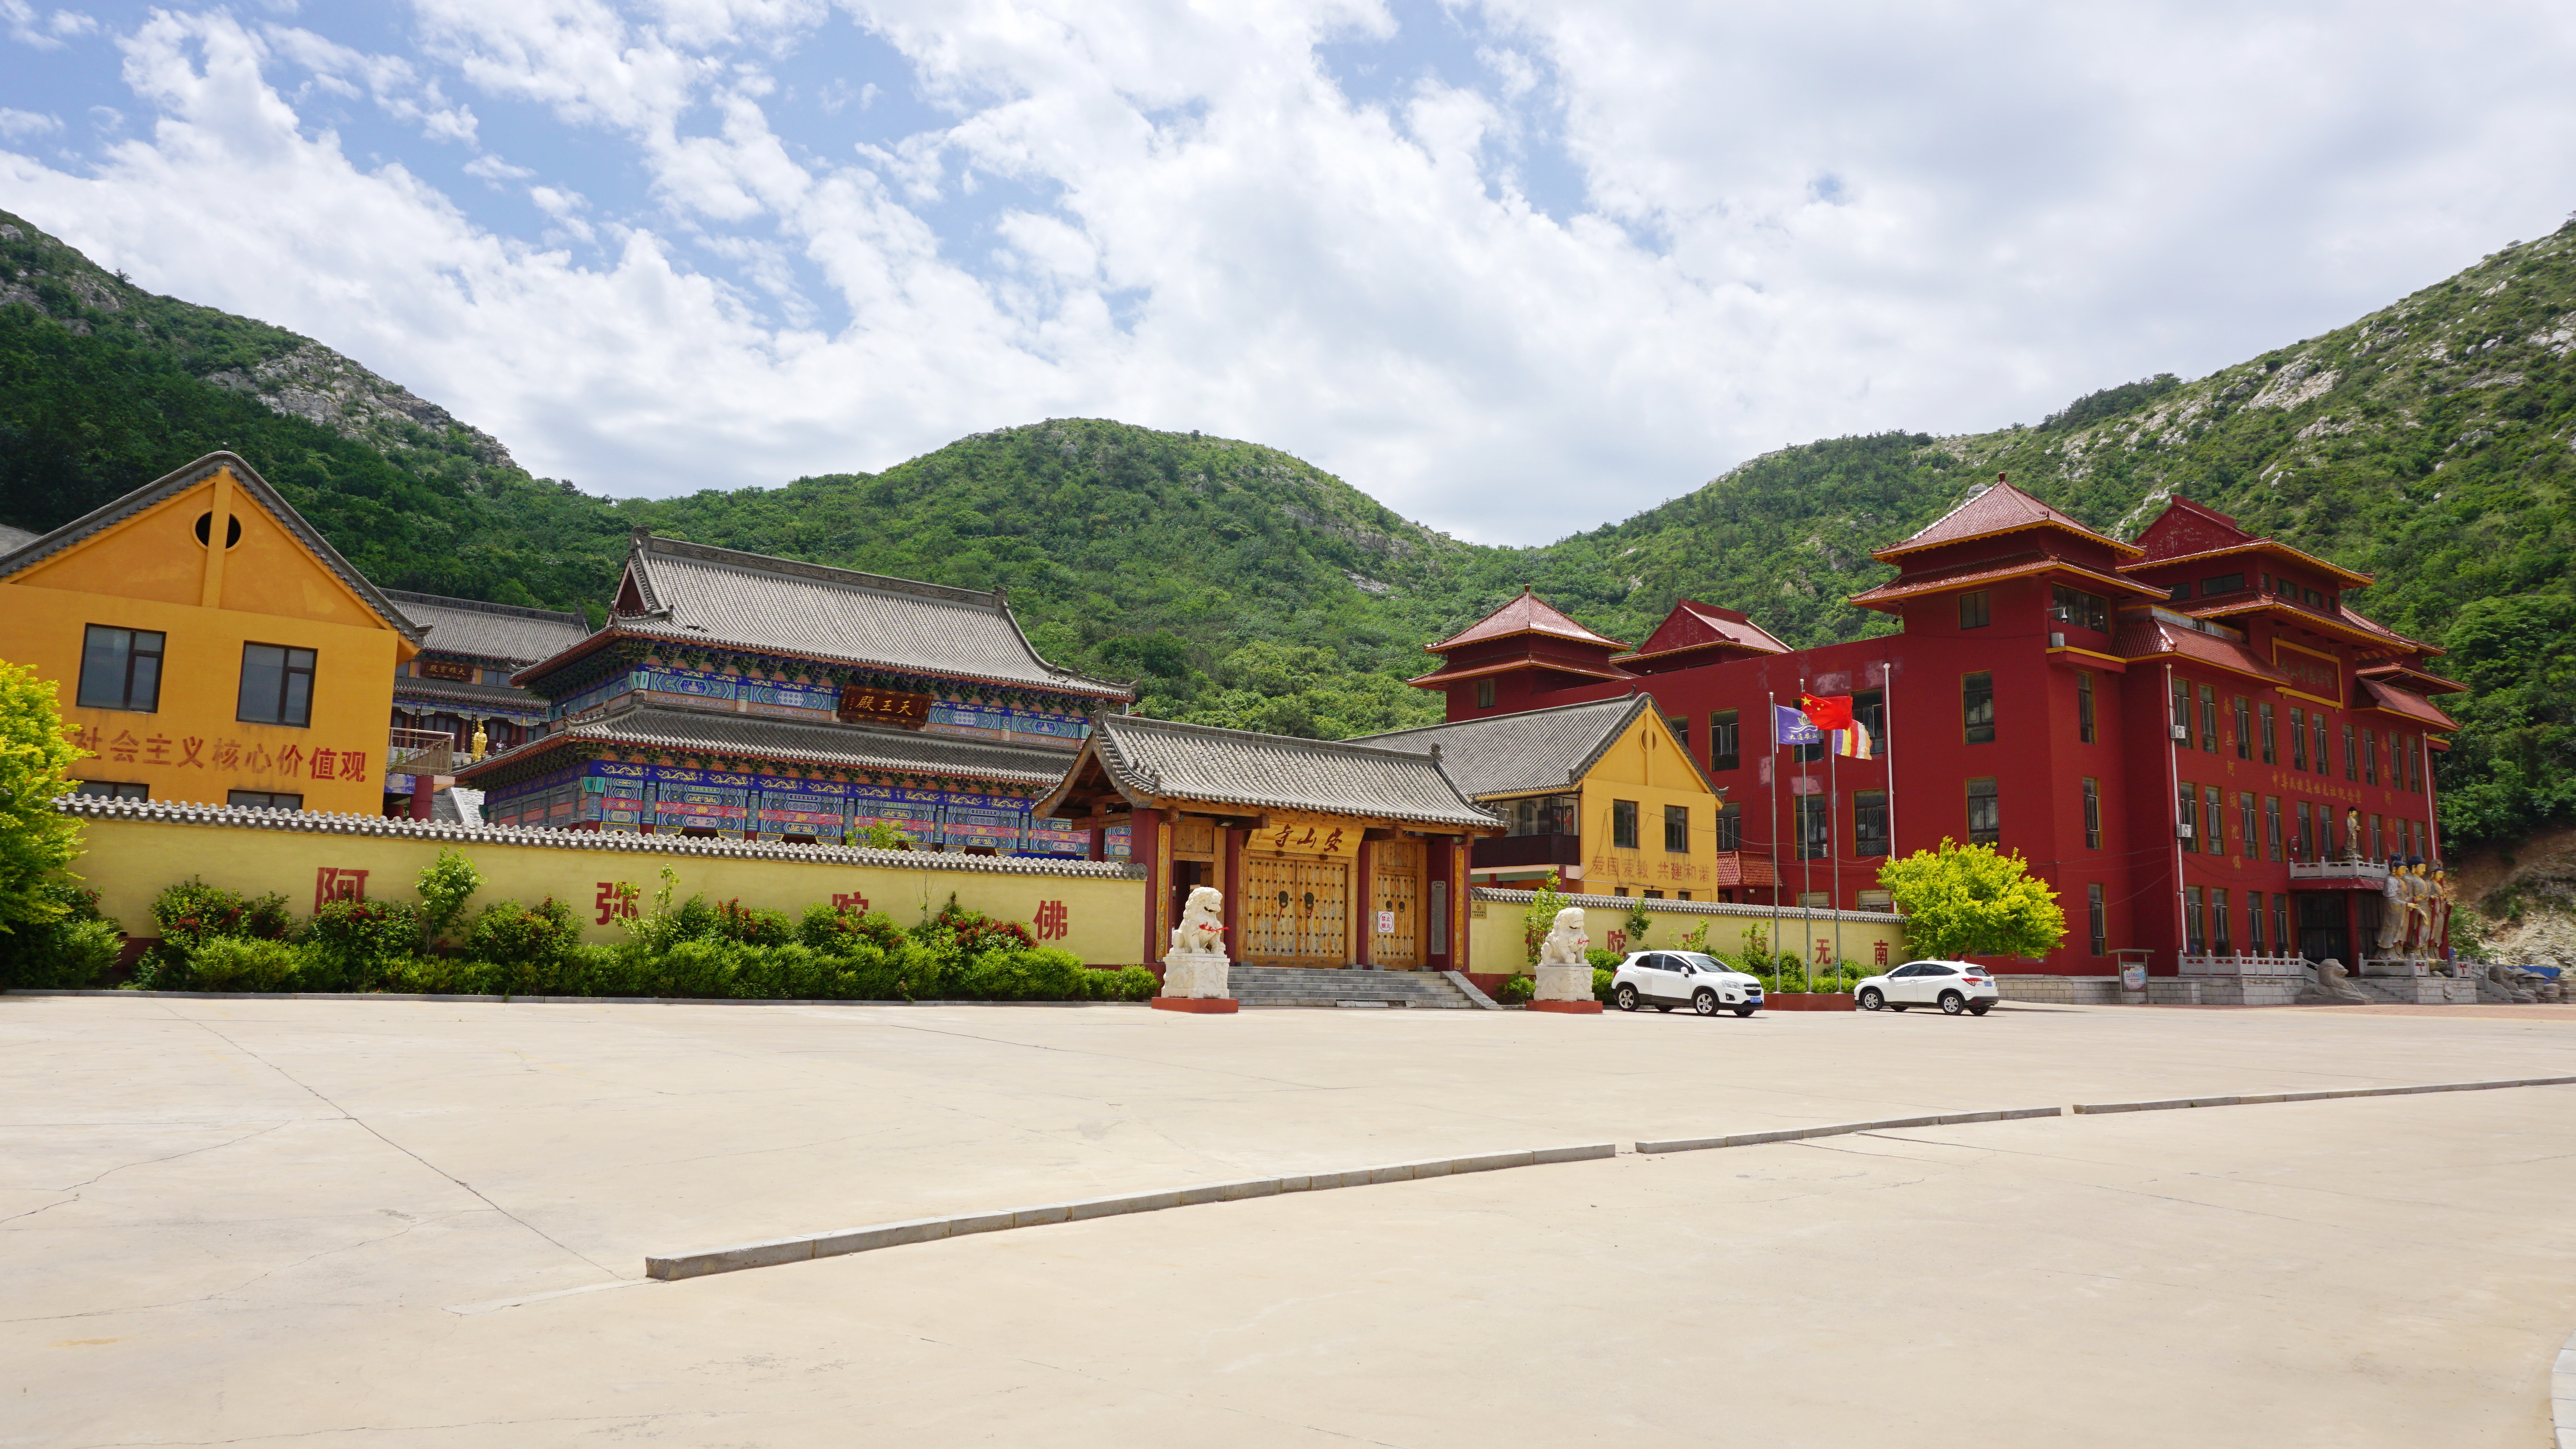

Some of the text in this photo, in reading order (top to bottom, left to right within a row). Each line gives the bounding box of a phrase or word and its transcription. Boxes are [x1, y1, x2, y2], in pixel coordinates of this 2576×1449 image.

[855, 695, 913, 716] 天王殿
[61, 725, 366, 782] 社会主义核心价值观
[1275, 824, 1343, 852] 安山寺
[1592, 856, 1710, 882] 爱国爱教 共建和谐
[1033, 900, 1067, 940] 佛
[1815, 939, 1831, 964] 无
[1874, 940, 1889, 965] 南
